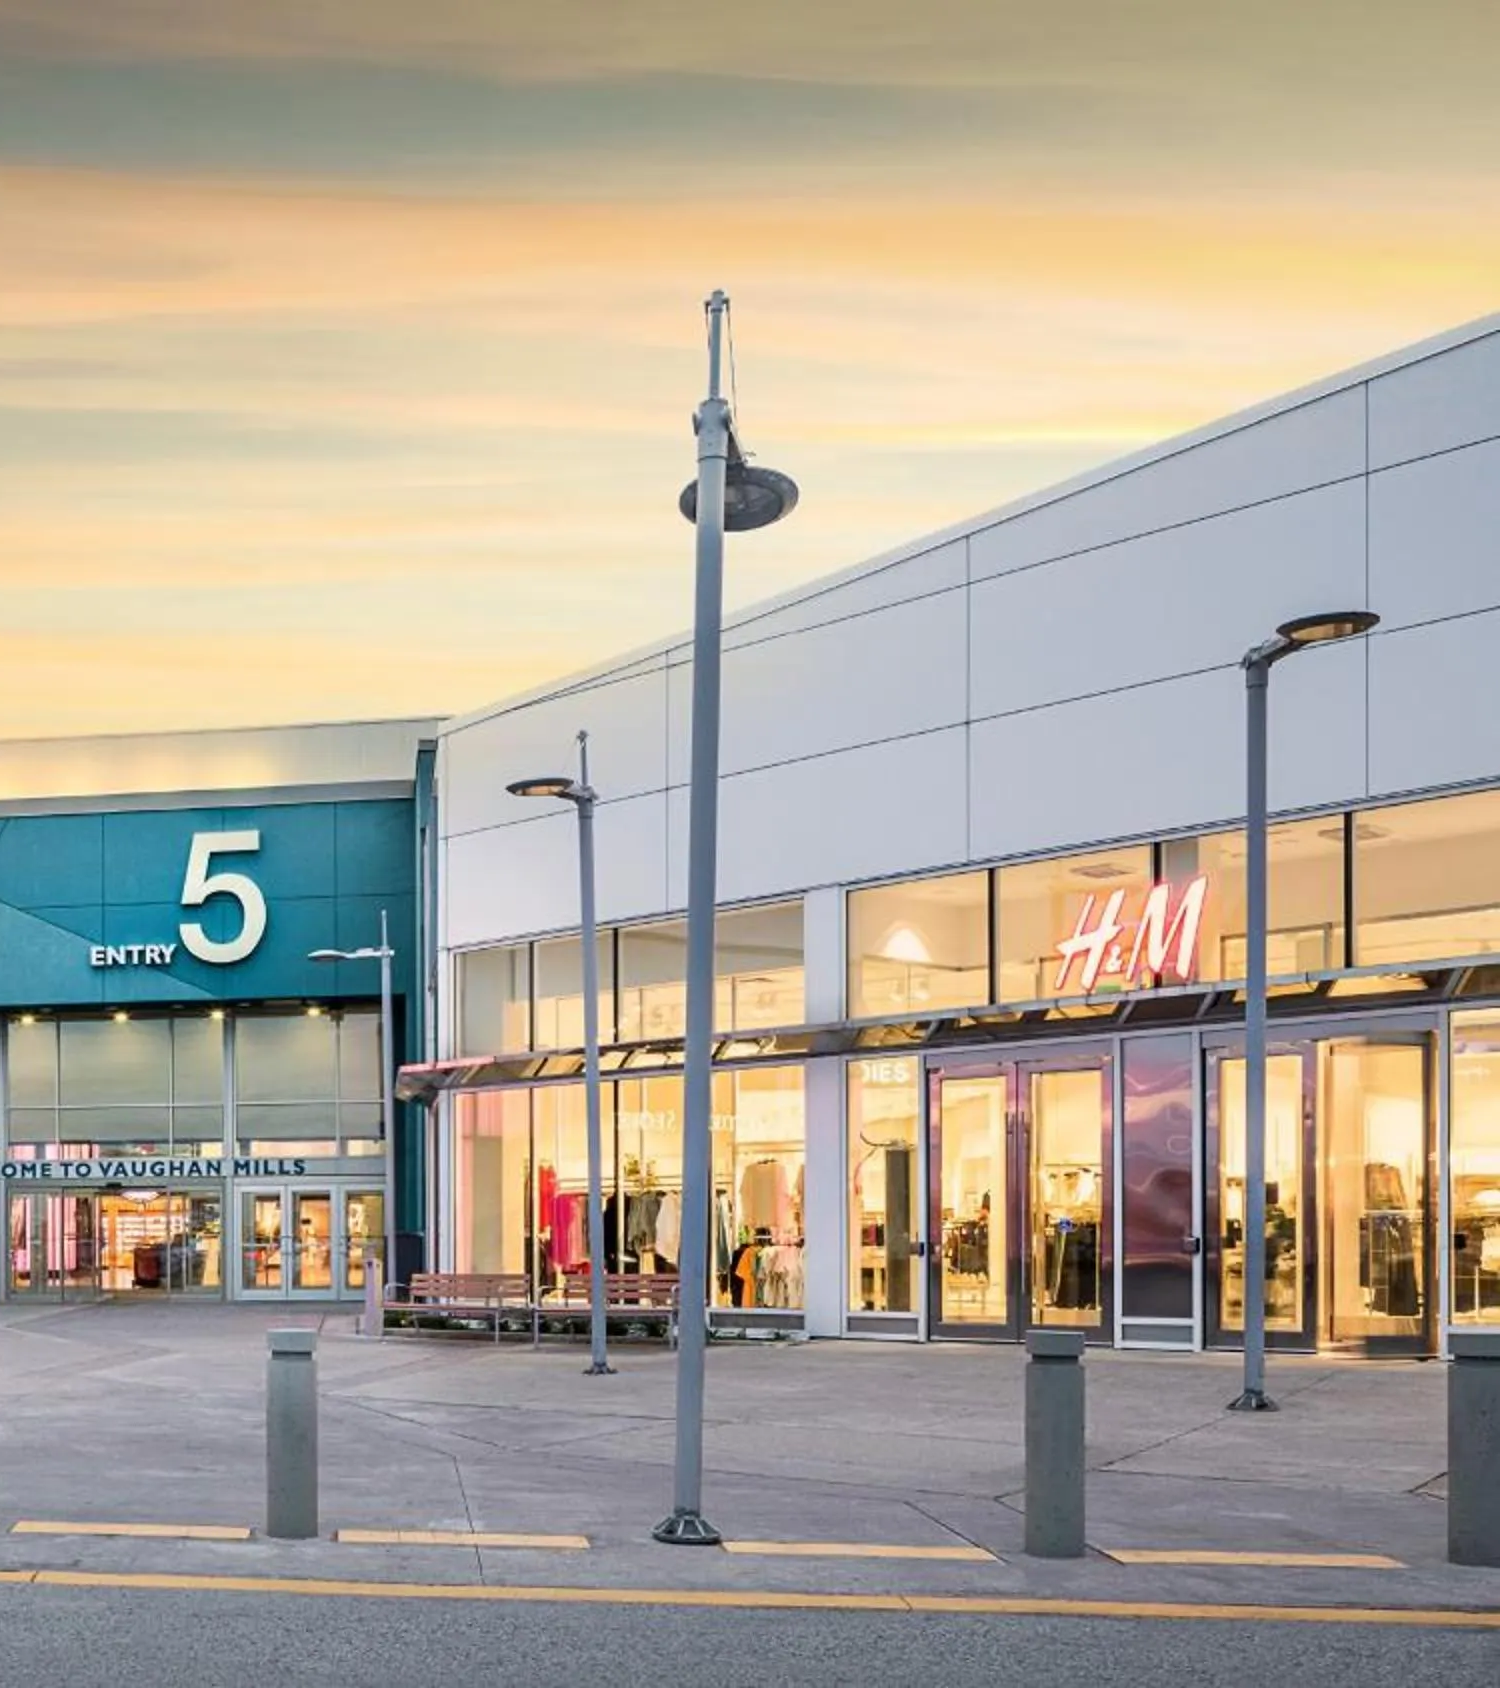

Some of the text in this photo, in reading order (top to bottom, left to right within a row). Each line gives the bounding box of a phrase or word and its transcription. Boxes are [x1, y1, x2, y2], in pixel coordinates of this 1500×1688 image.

[90, 829, 267, 966] ENTRY 5
[1054, 875, 1209, 991] H&M
[60, 1162, 91, 1178] TO
[99, 1159, 221, 1178] VAUGHAN
[233, 1158, 306, 1176] MILLS
